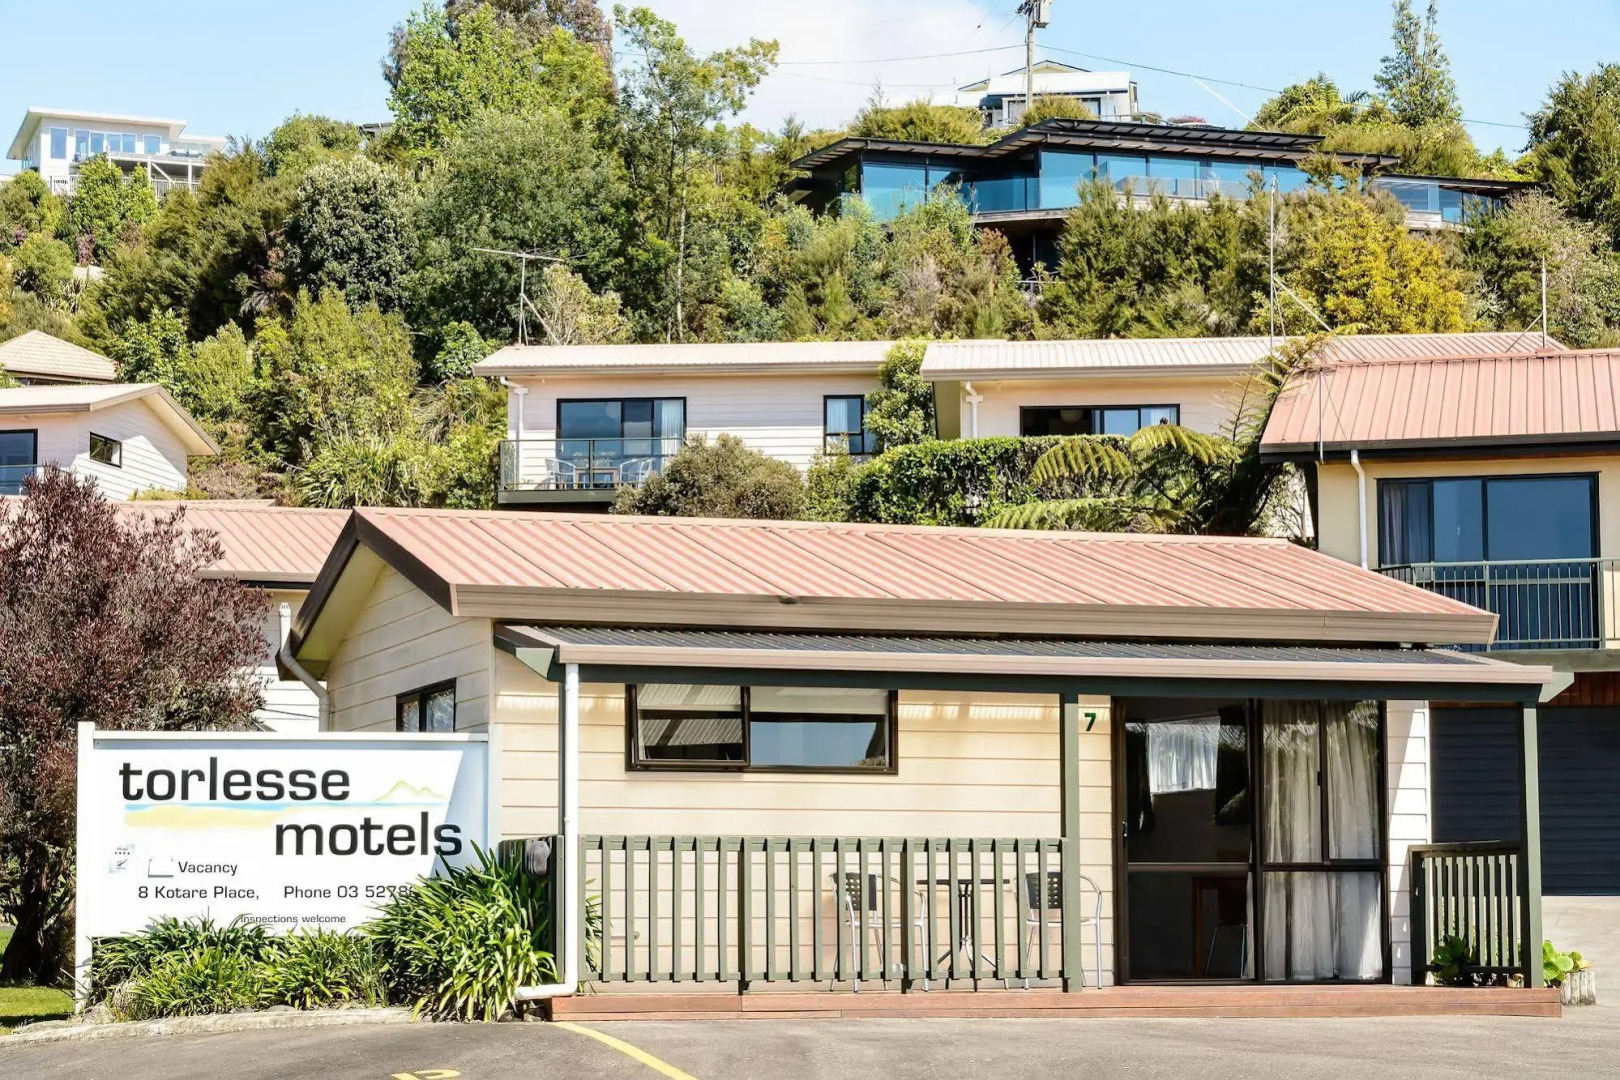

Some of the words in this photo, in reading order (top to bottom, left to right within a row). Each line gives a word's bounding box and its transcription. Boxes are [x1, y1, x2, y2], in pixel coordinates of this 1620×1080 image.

[1084, 712, 1097, 732] 7
[118, 756, 351, 801] torlesse
[275, 811, 464, 857] motels
[177, 861, 238, 877] Vacancy
[138, 885, 149, 899] 8
[155, 885, 208, 899] Kotare
[213, 885, 260, 901] Place,
[284, 885, 331, 899] Phone
[337, 885, 359, 899] 03
[301, 914, 346, 923] welcome
